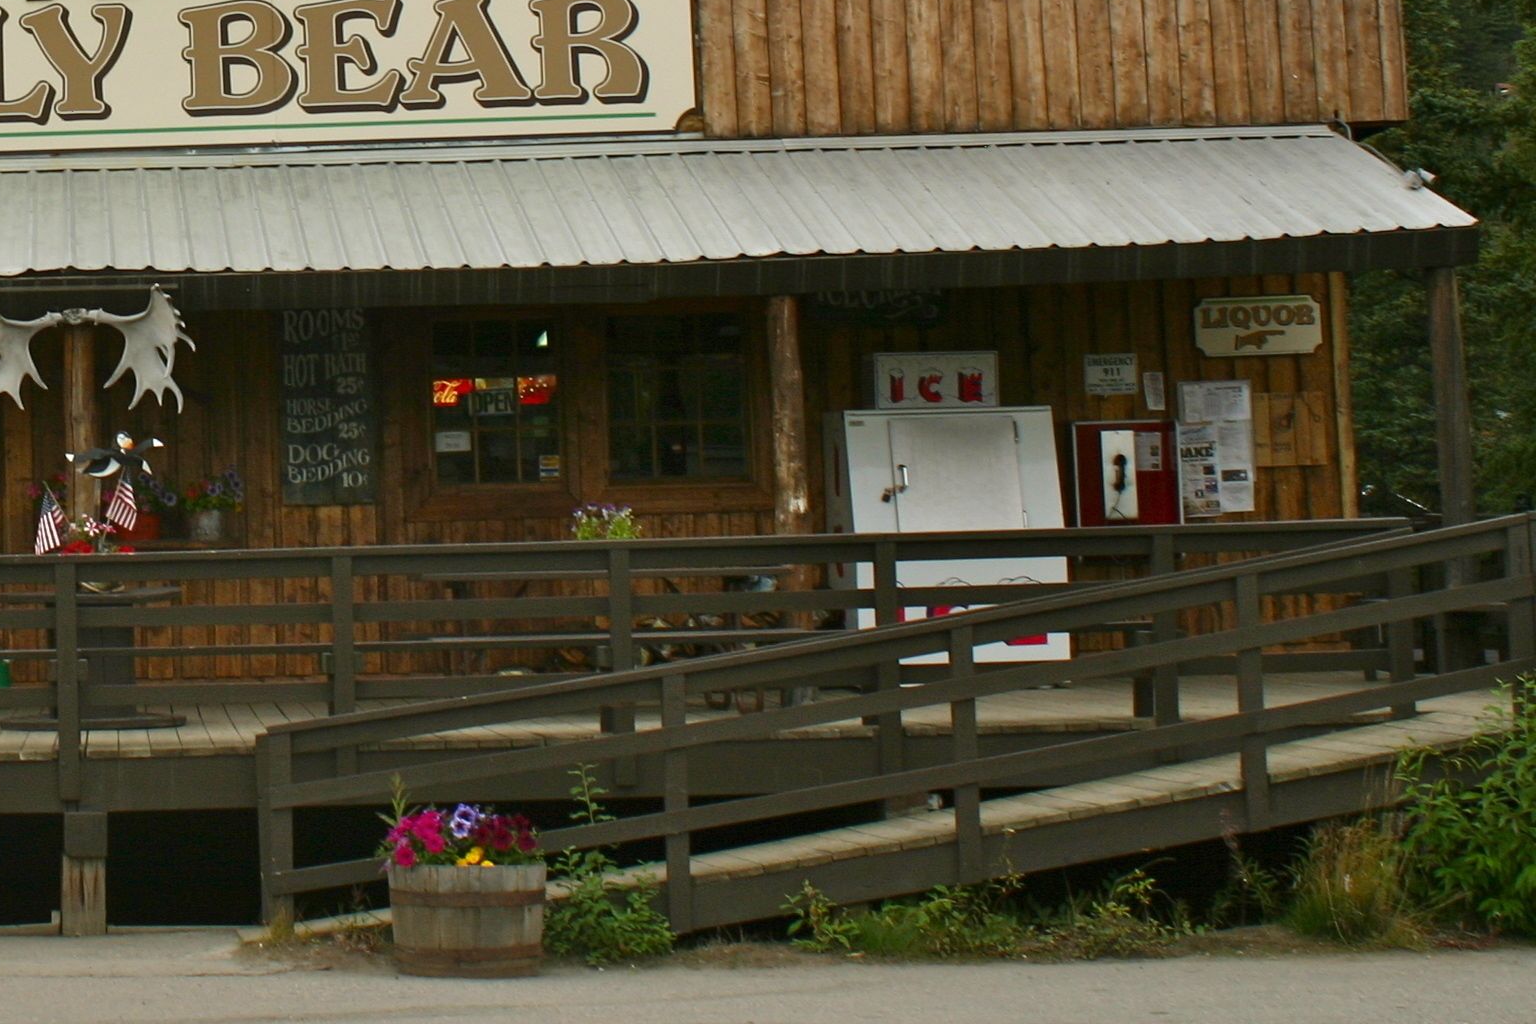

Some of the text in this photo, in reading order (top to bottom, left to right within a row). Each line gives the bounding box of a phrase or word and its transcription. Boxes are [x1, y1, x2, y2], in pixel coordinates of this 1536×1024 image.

[283, 308, 365, 343] ROOMS
[1199, 303, 1316, 329] LIQUOR
[283, 352, 367, 388] HOT BATH
[888, 366, 984, 404] ICE
[1103, 367, 1121, 377] 911
[286, 398, 332, 416] HORSE
[286, 399, 369, 434] BEDDING
[287, 443, 340, 465] DOG
[287, 448, 370, 484] BEDDING
